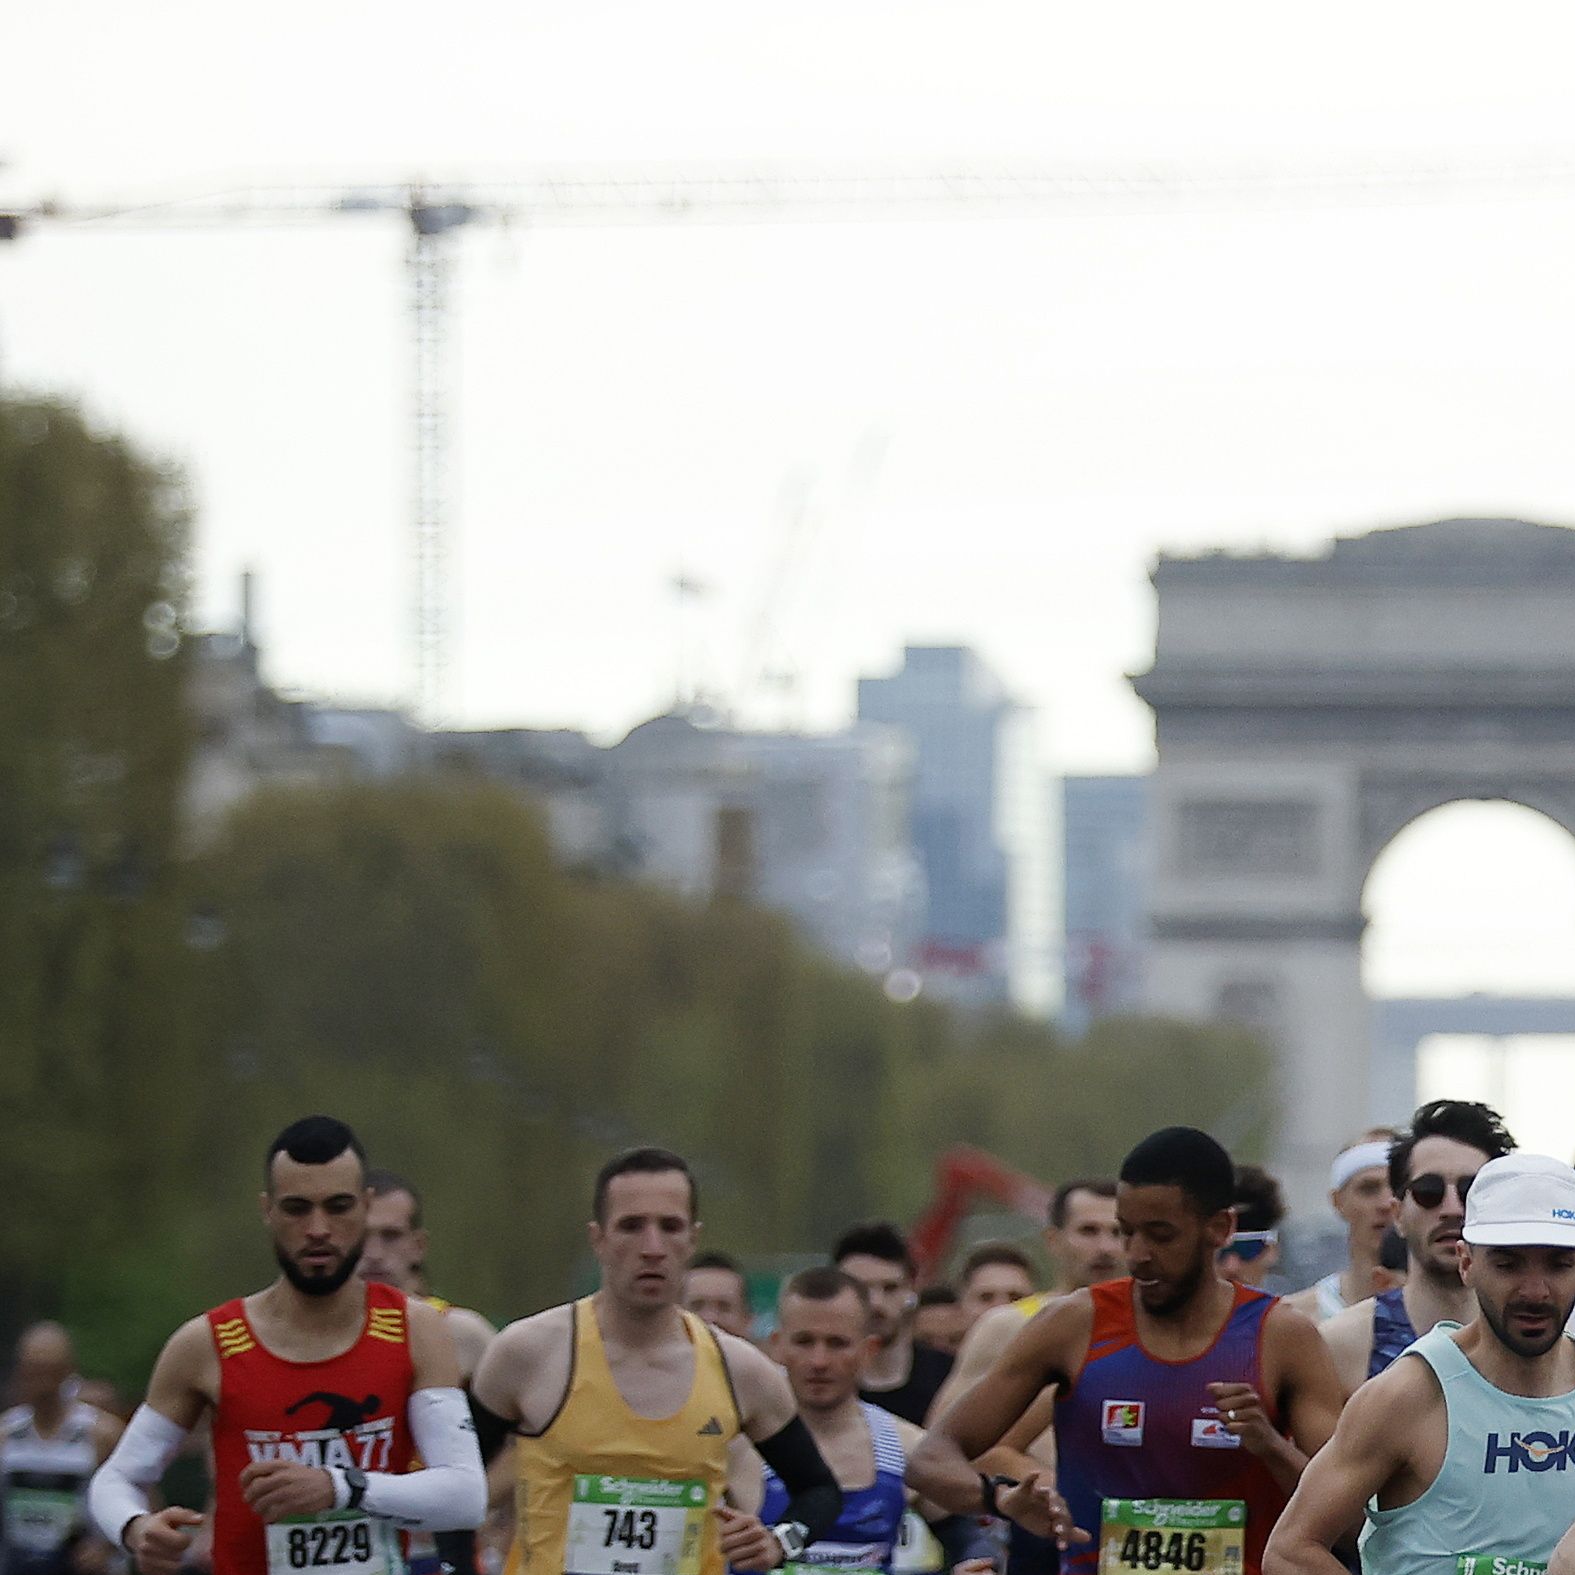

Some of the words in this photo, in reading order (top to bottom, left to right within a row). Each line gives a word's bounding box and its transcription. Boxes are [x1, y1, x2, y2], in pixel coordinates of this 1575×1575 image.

[355, 1430, 394, 1470] 77
[288, 1522, 371, 1569] 8229
[603, 1509, 657, 1550] 743
[1121, 1529, 1206, 1571] 4846
